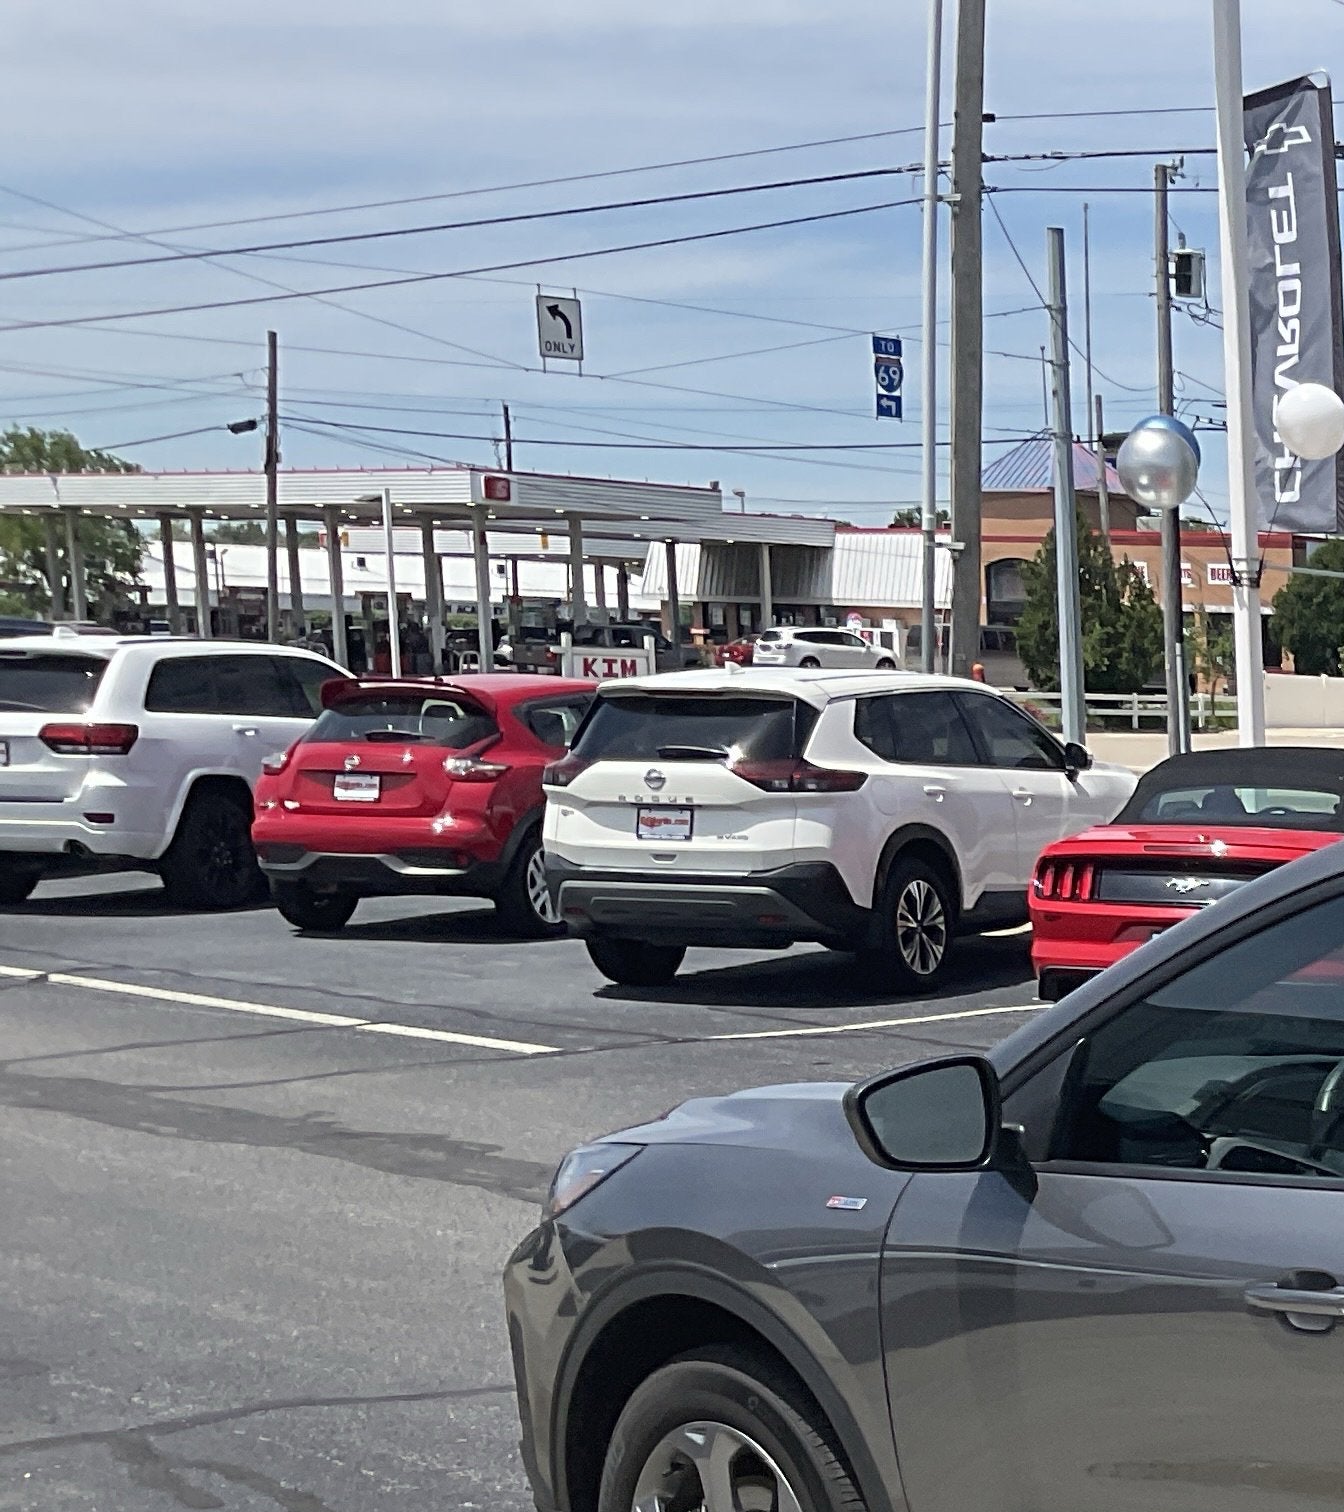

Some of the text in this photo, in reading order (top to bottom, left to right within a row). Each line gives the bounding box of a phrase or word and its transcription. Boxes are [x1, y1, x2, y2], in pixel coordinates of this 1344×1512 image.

[544, 341, 575, 353] ONLY
[881, 341, 895, 353] TO
[878, 366, 900, 386] 69
[583, 657, 637, 678] KIM
